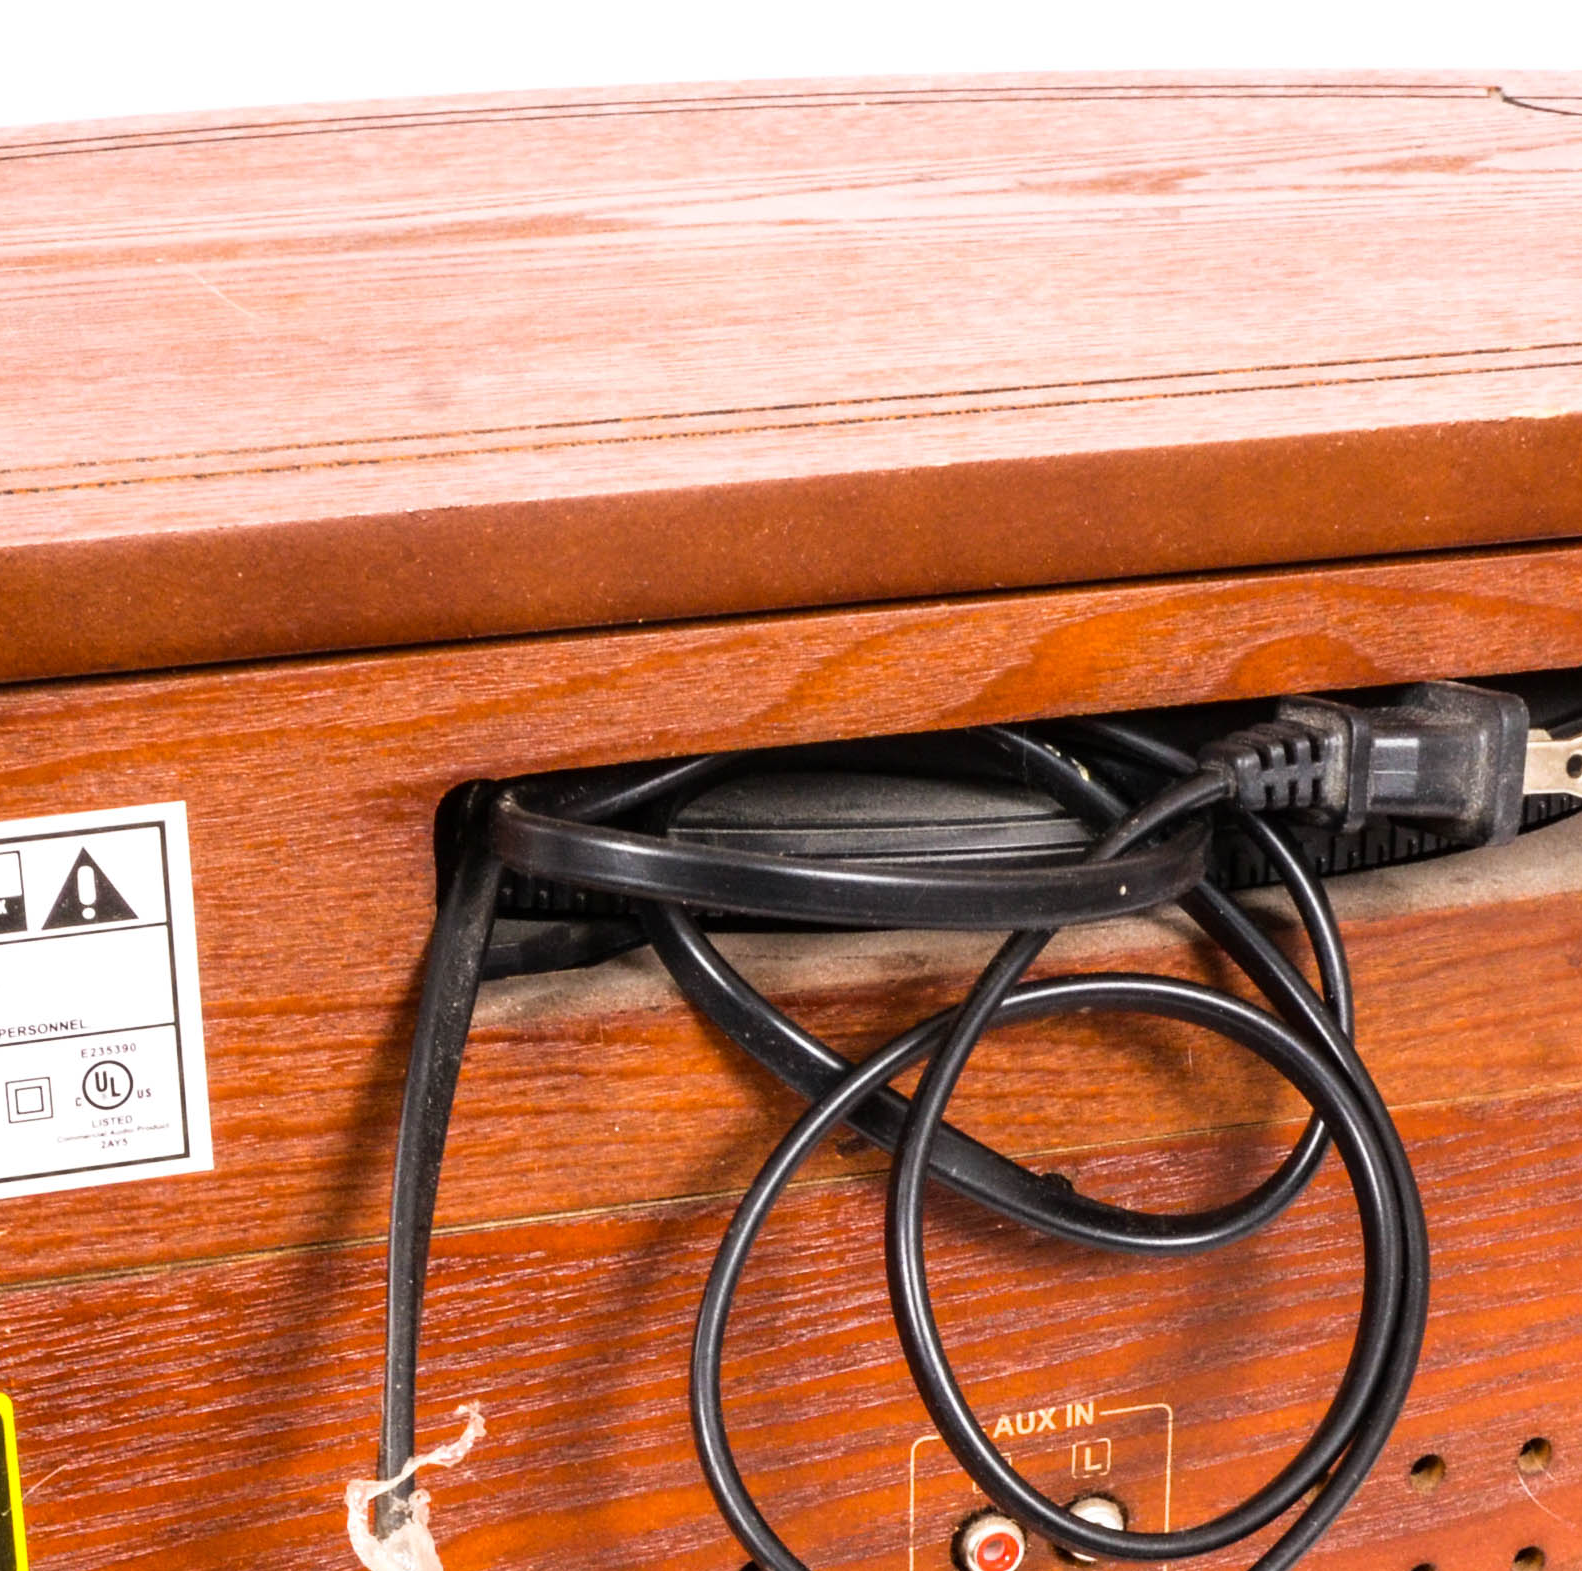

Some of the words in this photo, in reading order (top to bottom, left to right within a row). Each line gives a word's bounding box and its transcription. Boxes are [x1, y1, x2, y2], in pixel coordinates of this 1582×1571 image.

[993, 1409, 1057, 1439] AUX
[1066, 1401, 1094, 1427] IN
[1084, 1446, 1102, 1471] L
